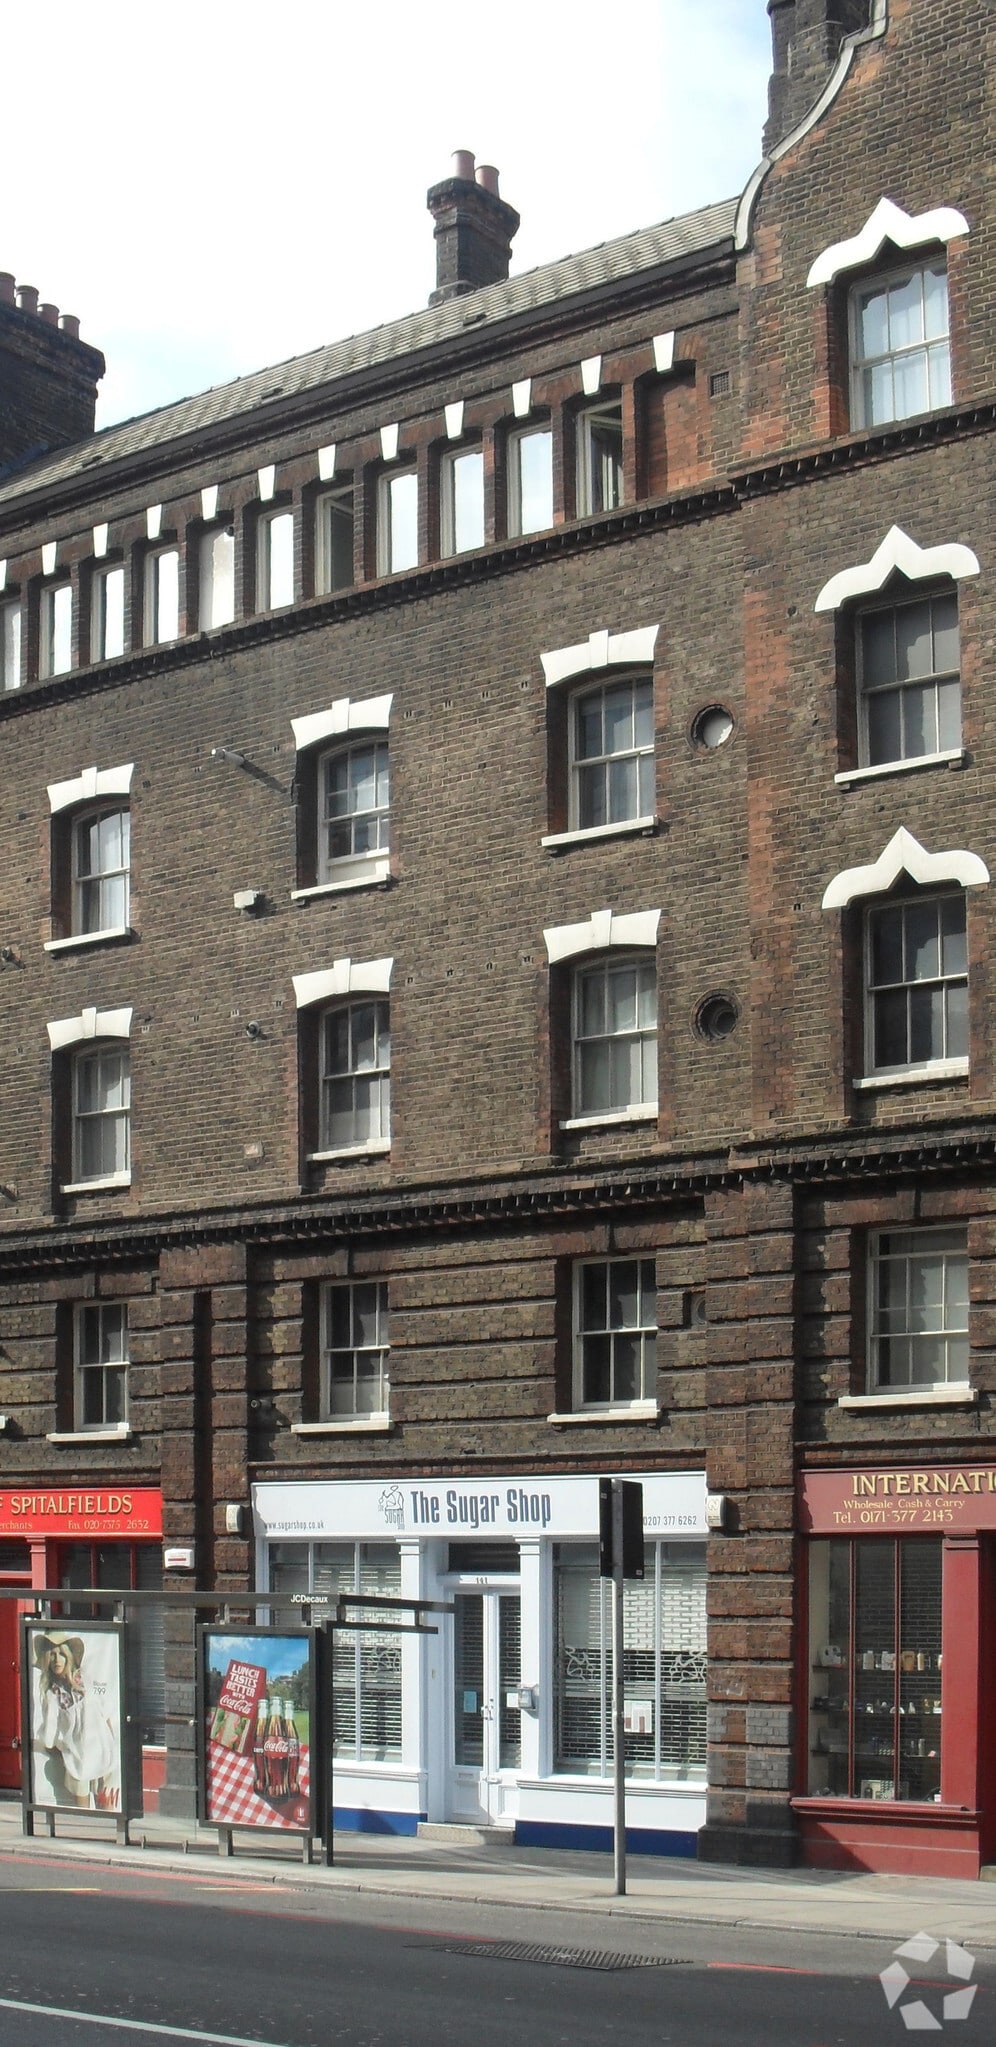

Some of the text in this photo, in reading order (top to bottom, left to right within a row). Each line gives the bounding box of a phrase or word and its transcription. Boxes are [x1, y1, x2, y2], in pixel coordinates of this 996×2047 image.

[852, 1472, 996, 1495] INTERNATI
[11, 1496, 132, 1515] SPITALFIELDS
[410, 1488, 551, 1529] The Sugar Shop
[843, 1497, 965, 1509] Wholesale Cash & Carry
[643, 1516, 661, 1526] 0207
[663, 1515, 675, 1526] 377
[678, 1515, 697, 1526] 6262
[833, 1511, 856, 1523] Tel.
[922, 1509, 953, 1522] 2143
[264, 1520, 324, 1531] www.sugarshop.co.uk
[290, 1594, 328, 1603] JCDecaux
[232, 1664, 260, 1679] LUNCH
[230, 1672, 258, 1688] TASTES
[226, 1680, 256, 1698] BETTER
